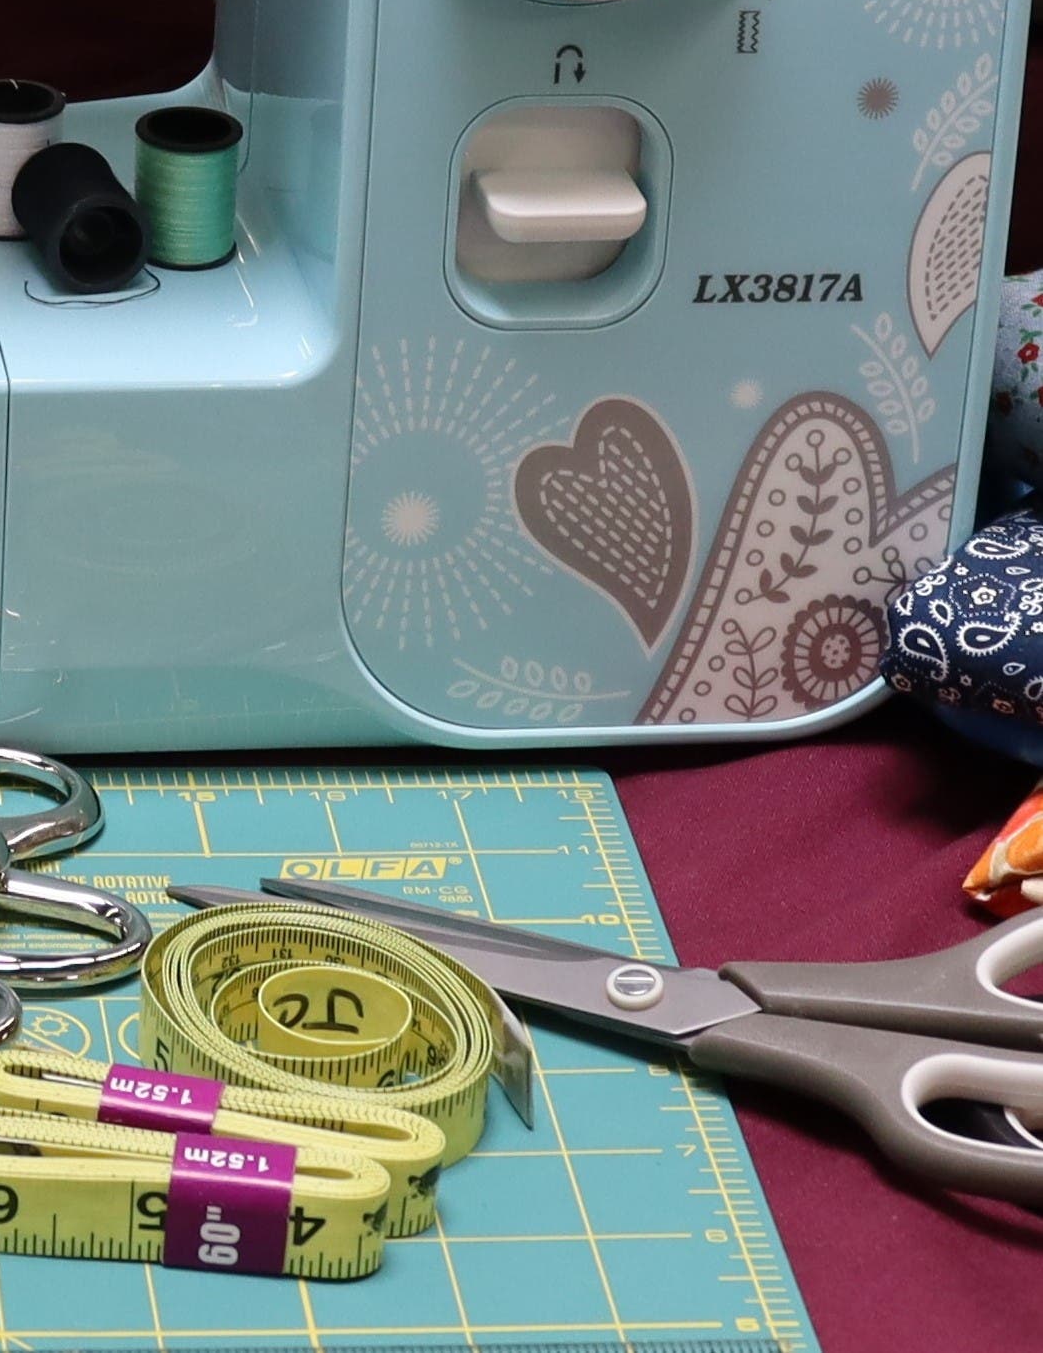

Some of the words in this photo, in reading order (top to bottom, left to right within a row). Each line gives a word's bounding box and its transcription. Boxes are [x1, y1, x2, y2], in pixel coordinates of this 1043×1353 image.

[692, 273, 864, 303] LX3817A
[437, 789, 474, 800] 17
[283, 858, 444, 879] OLFA
[403, 885, 469, 895] RM-CG
[110, 1077, 193, 1105] 1.52m
[183, 1146, 269, 1173] 1.52m
[289, 1206, 327, 1246] 4
